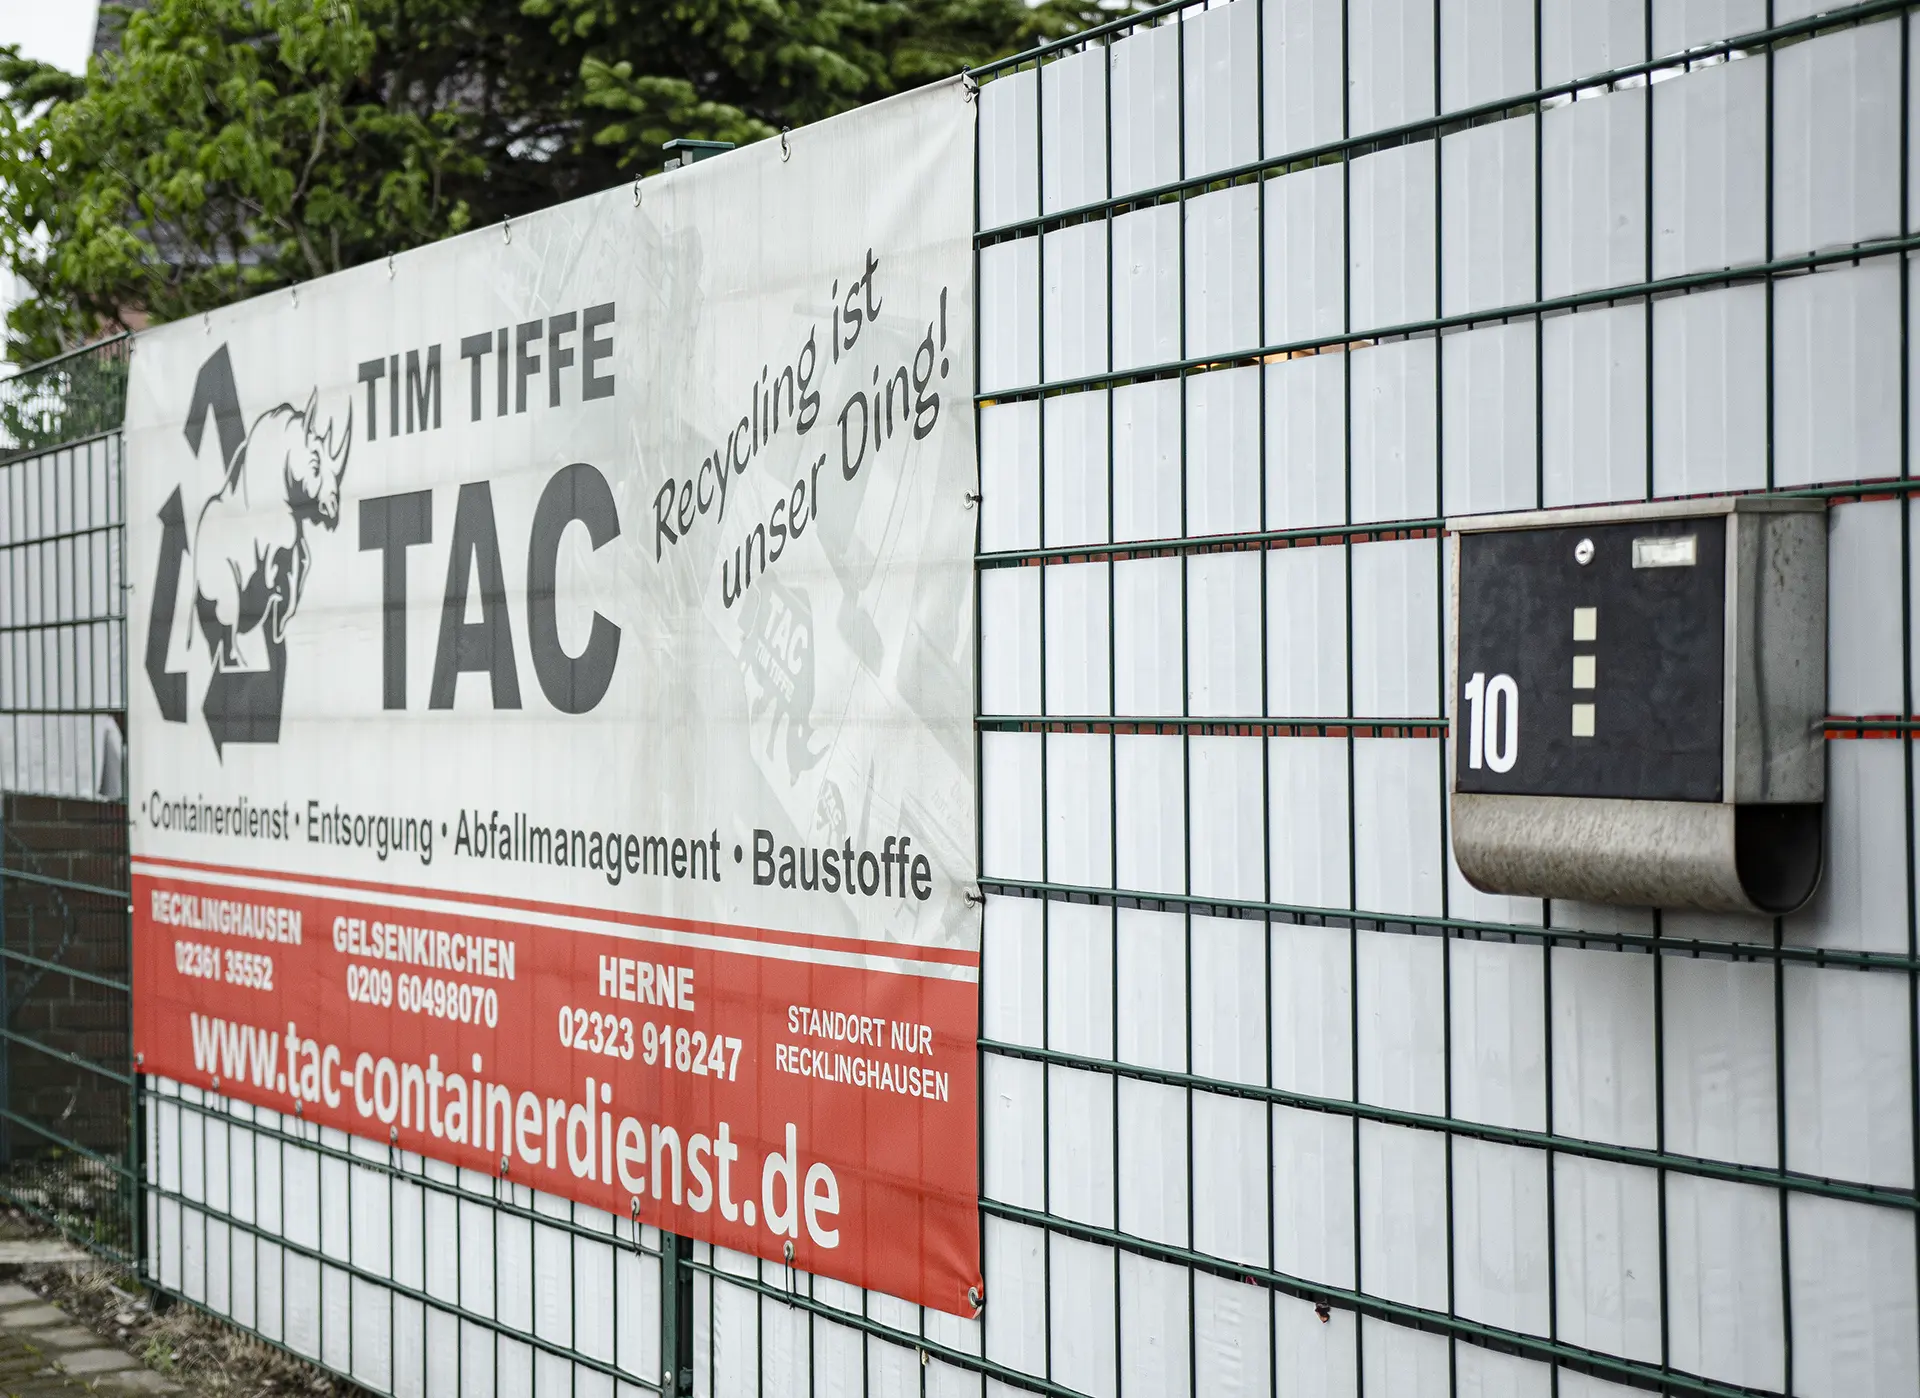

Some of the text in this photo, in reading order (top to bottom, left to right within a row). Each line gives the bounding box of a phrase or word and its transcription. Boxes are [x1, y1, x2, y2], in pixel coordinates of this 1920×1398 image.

[358, 302, 615, 441] TIM TIFFE
[653, 248, 882, 564] Recycling ist
[722, 286, 949, 609] unser Ding!
[358, 463, 621, 715] TAC
[1464, 672, 1519, 773] 10
[150, 791, 932, 901] Containerdienst Entsorgung Abfallmanagement Baustoffe
[151, 889, 302, 945] RECKLINGHAUSEN
[333, 916, 515, 981] GELSENKIRCHEN
[175, 940, 273, 991] 02361 35552
[347, 964, 498, 1028] 0209 60498070
[599, 954, 695, 1011] HERNE
[559, 1005, 742, 1081] 02323 918247
[788, 1005, 932, 1056] STANDORT NUR
[776, 1043, 949, 1102] RECKLINGHAUSEN
[190, 1012, 840, 1249] www.tac-containerdienst.de
